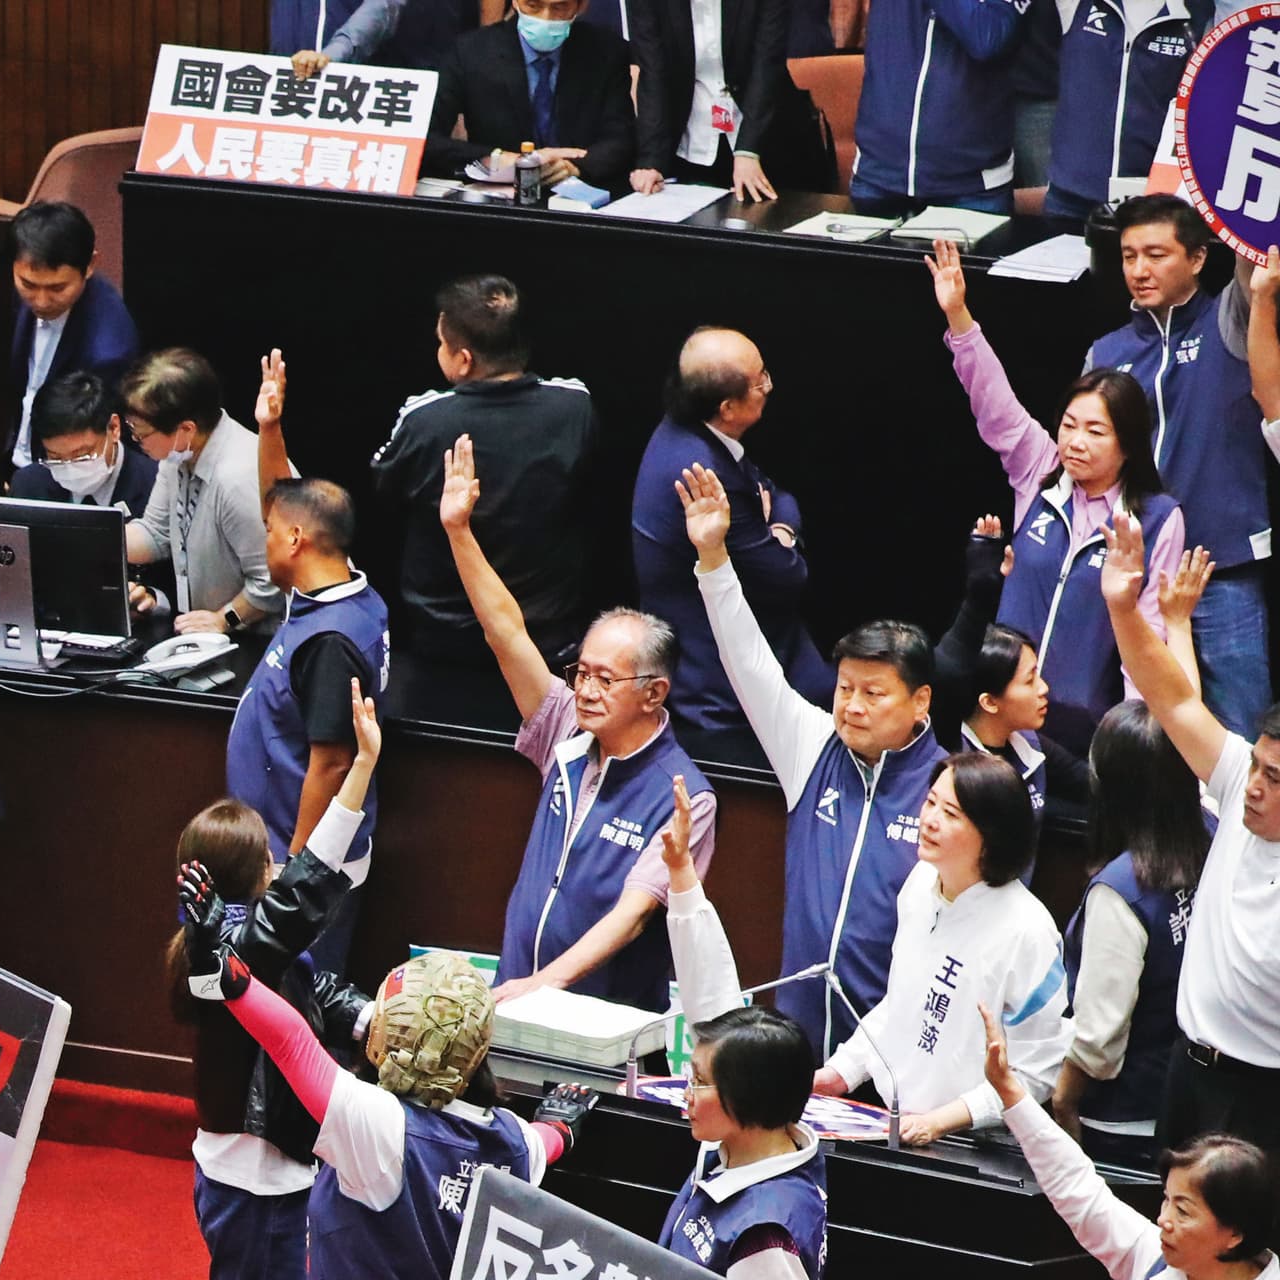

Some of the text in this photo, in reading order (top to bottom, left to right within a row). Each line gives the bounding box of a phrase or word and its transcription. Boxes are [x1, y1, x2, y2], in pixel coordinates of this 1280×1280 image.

[170, 58, 419, 127] 國會要改革
[156, 123, 407, 194] 人民要真相
[917, 955, 964, 1055] 王鴻薇
